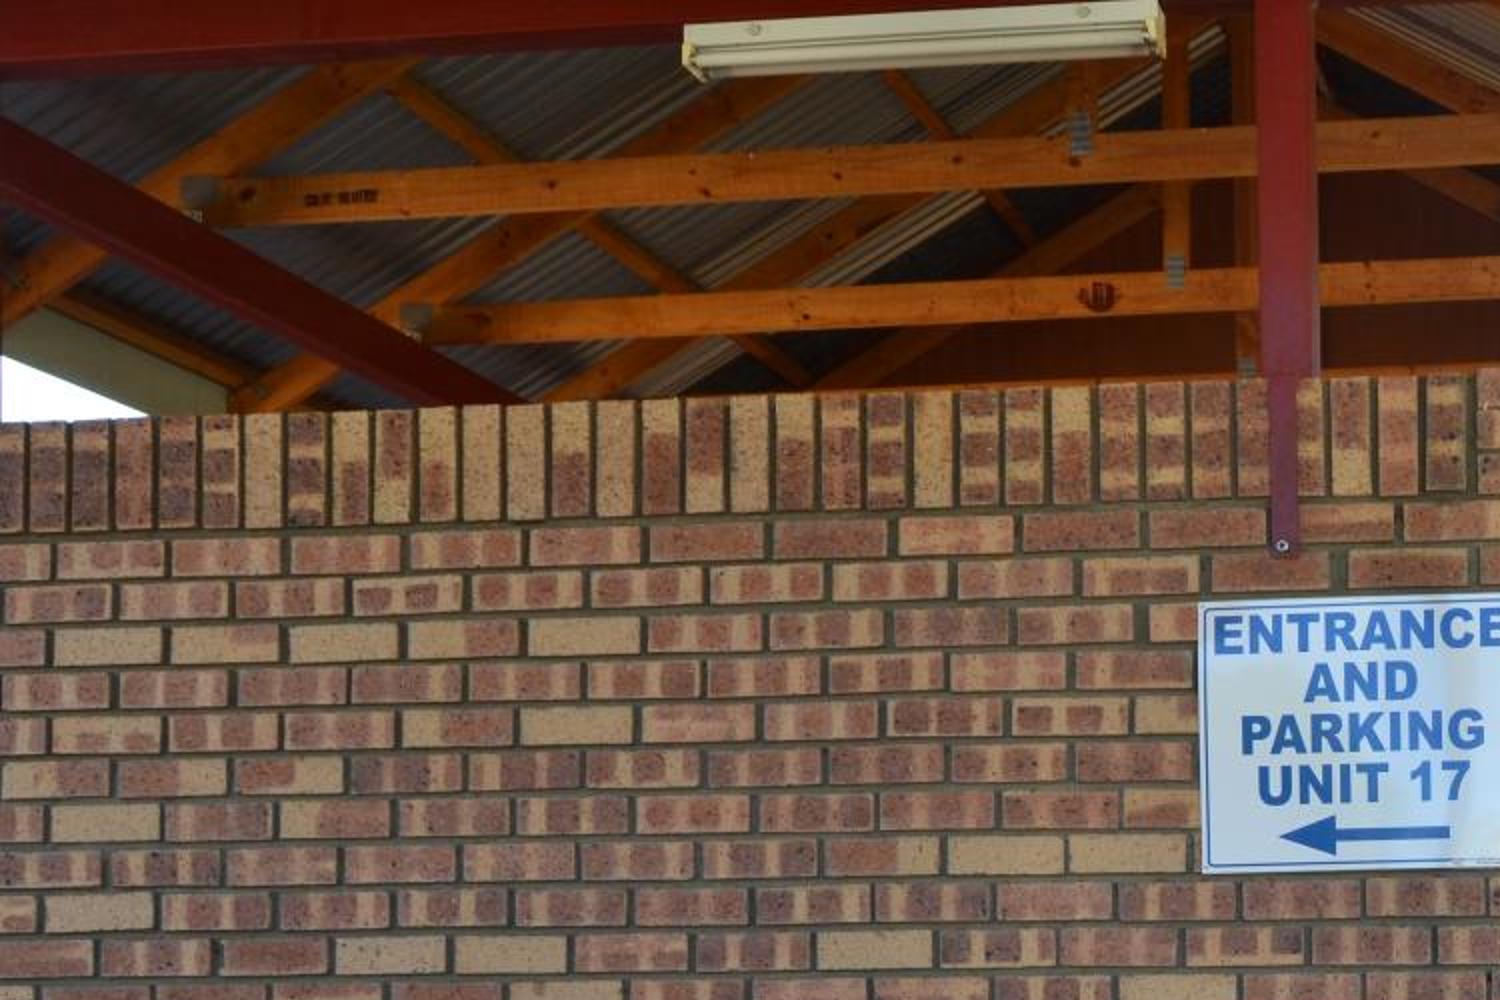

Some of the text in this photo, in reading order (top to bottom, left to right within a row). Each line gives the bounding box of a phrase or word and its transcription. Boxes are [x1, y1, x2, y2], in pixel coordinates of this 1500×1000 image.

[1304, 661, 1417, 702] AND
[1242, 709, 1484, 755] PARKING
[1258, 760, 1470, 806] UNIT 17
